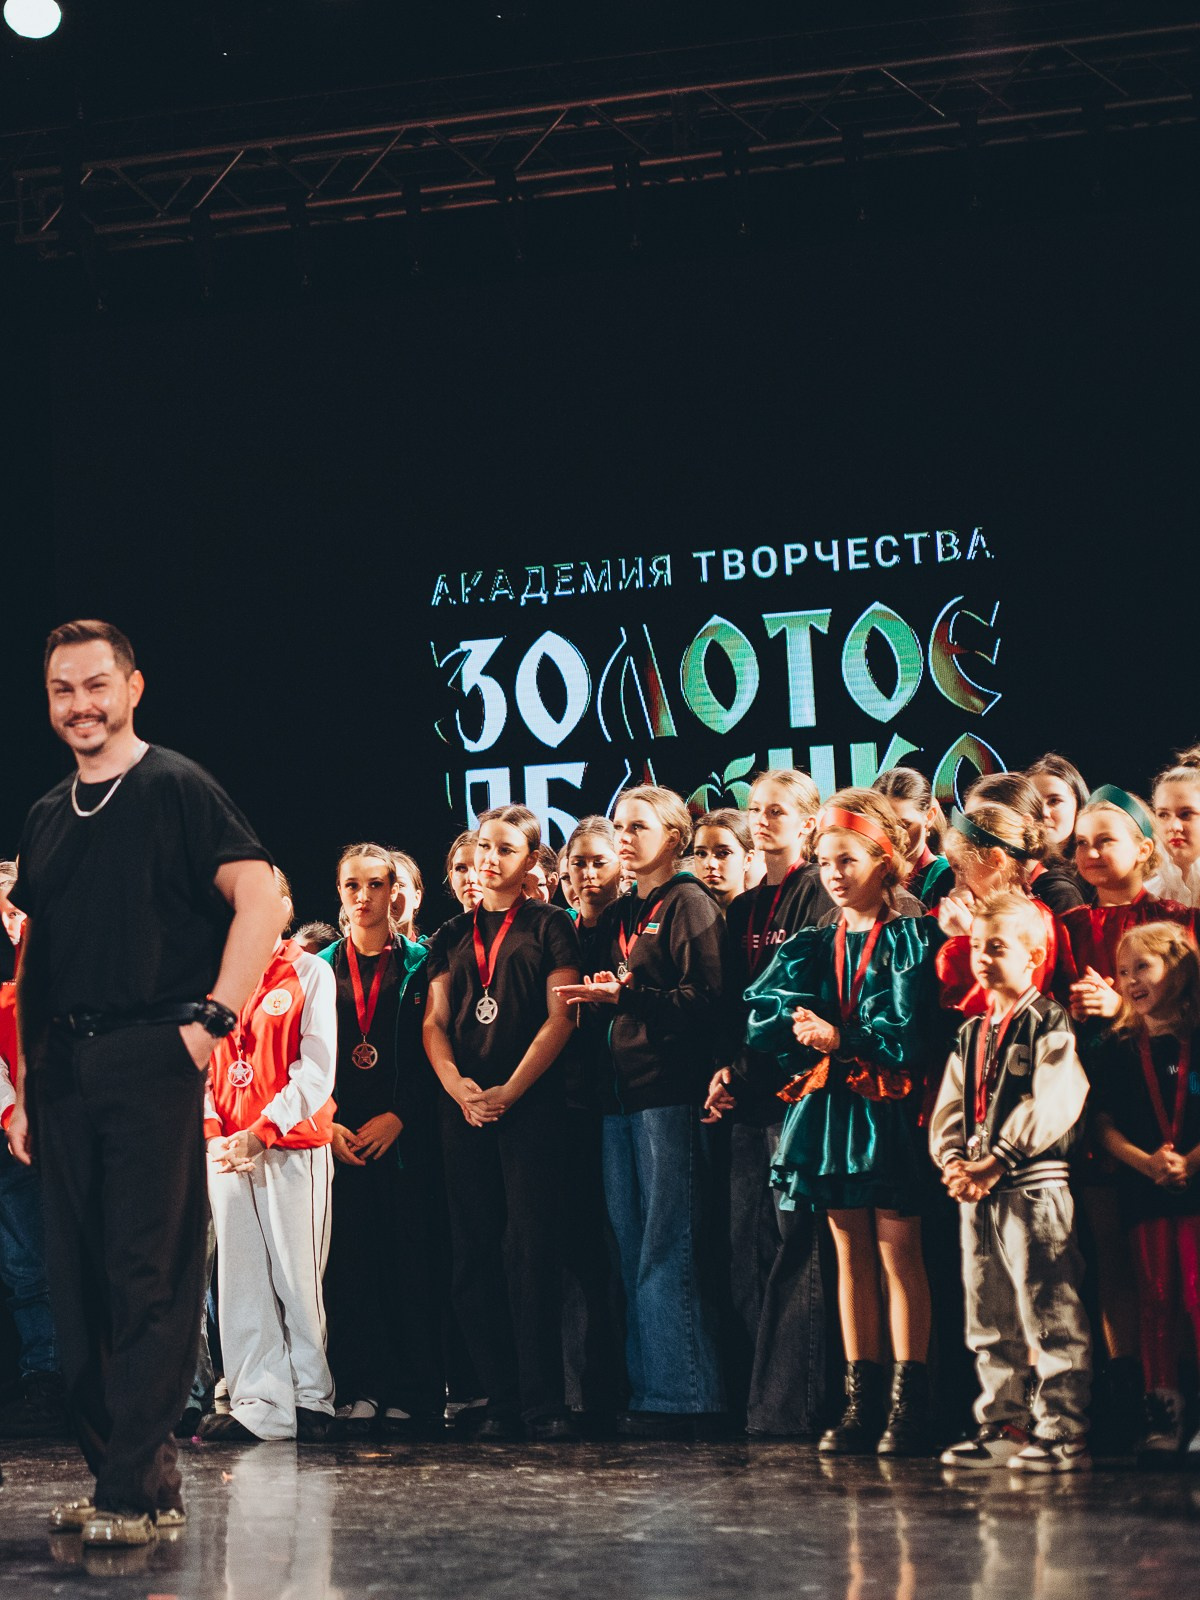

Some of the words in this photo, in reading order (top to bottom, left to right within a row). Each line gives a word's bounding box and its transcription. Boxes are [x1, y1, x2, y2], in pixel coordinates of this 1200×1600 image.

[431, 553, 673, 607] АКАДЕМИЯ
[692, 526, 995, 583] ТВОРЧЕСТВА
[430, 596, 1002, 753] ЗОЛОТОЕ
